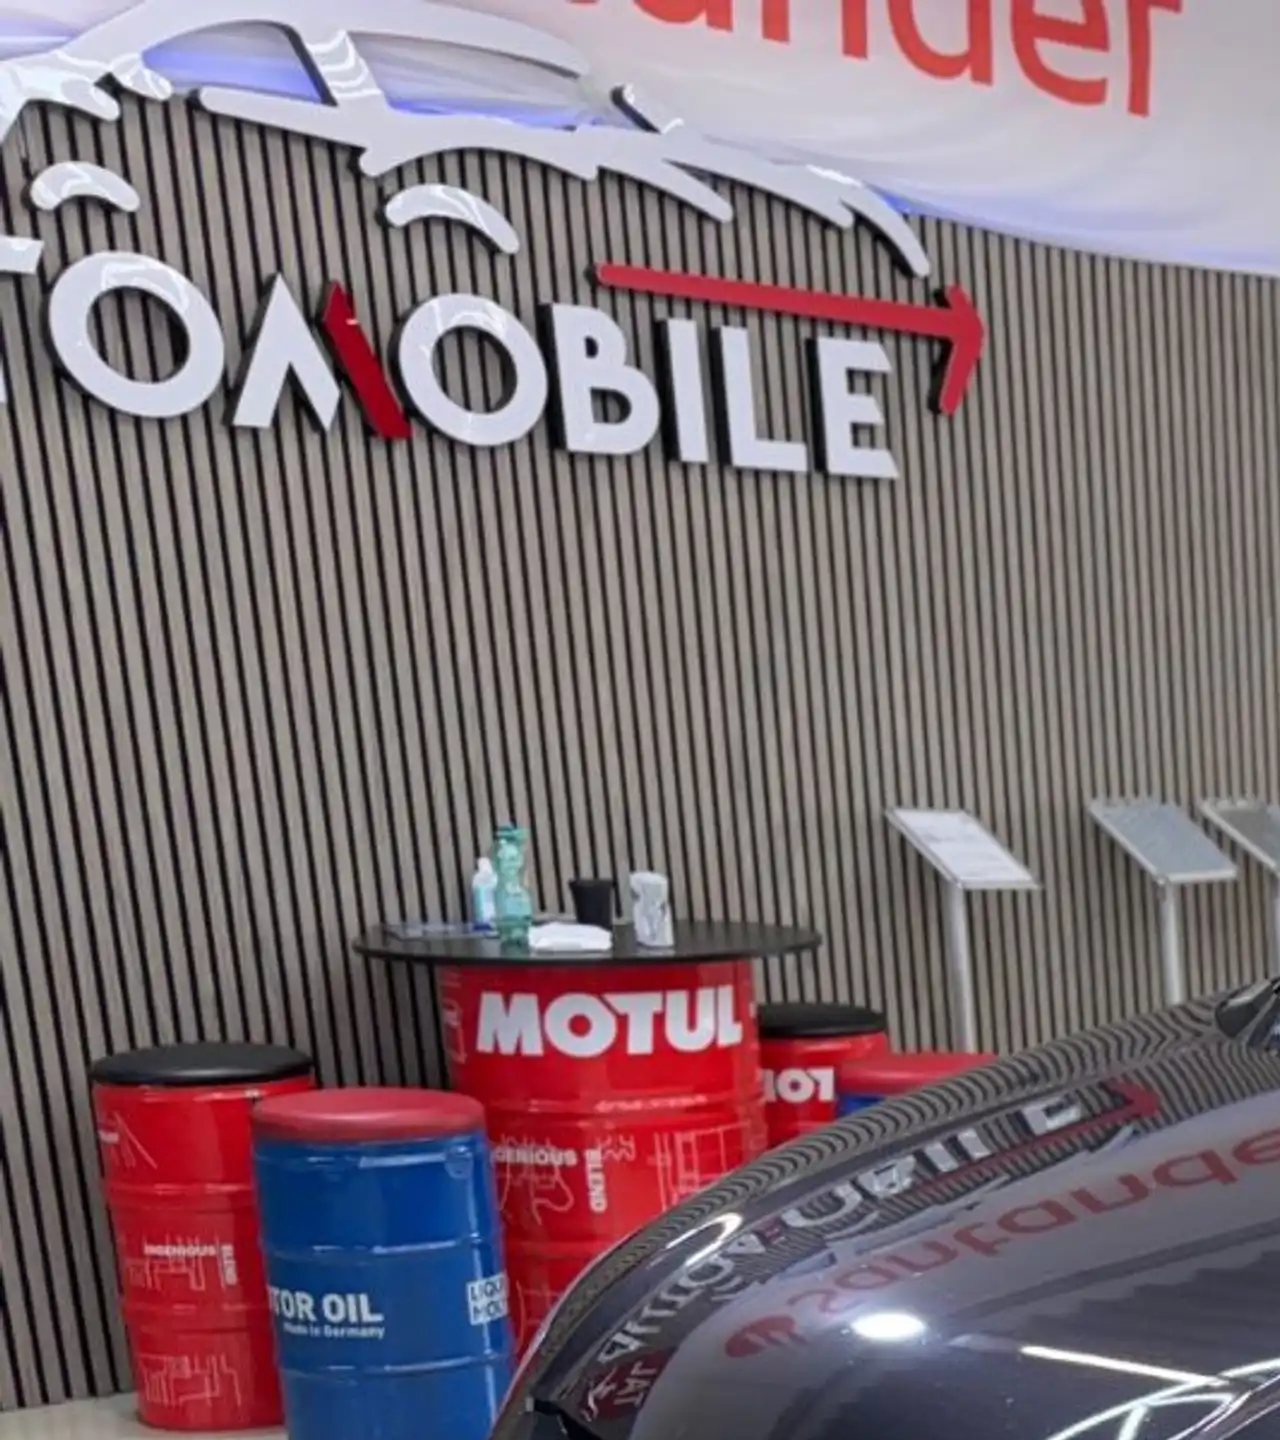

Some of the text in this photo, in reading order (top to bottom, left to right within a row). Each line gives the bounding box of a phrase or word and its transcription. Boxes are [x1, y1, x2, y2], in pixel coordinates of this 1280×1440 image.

[476, 984, 743, 1058] MOTUL
[322, 1293, 385, 1324] OIL
[324, 1324, 385, 1340] Germany
